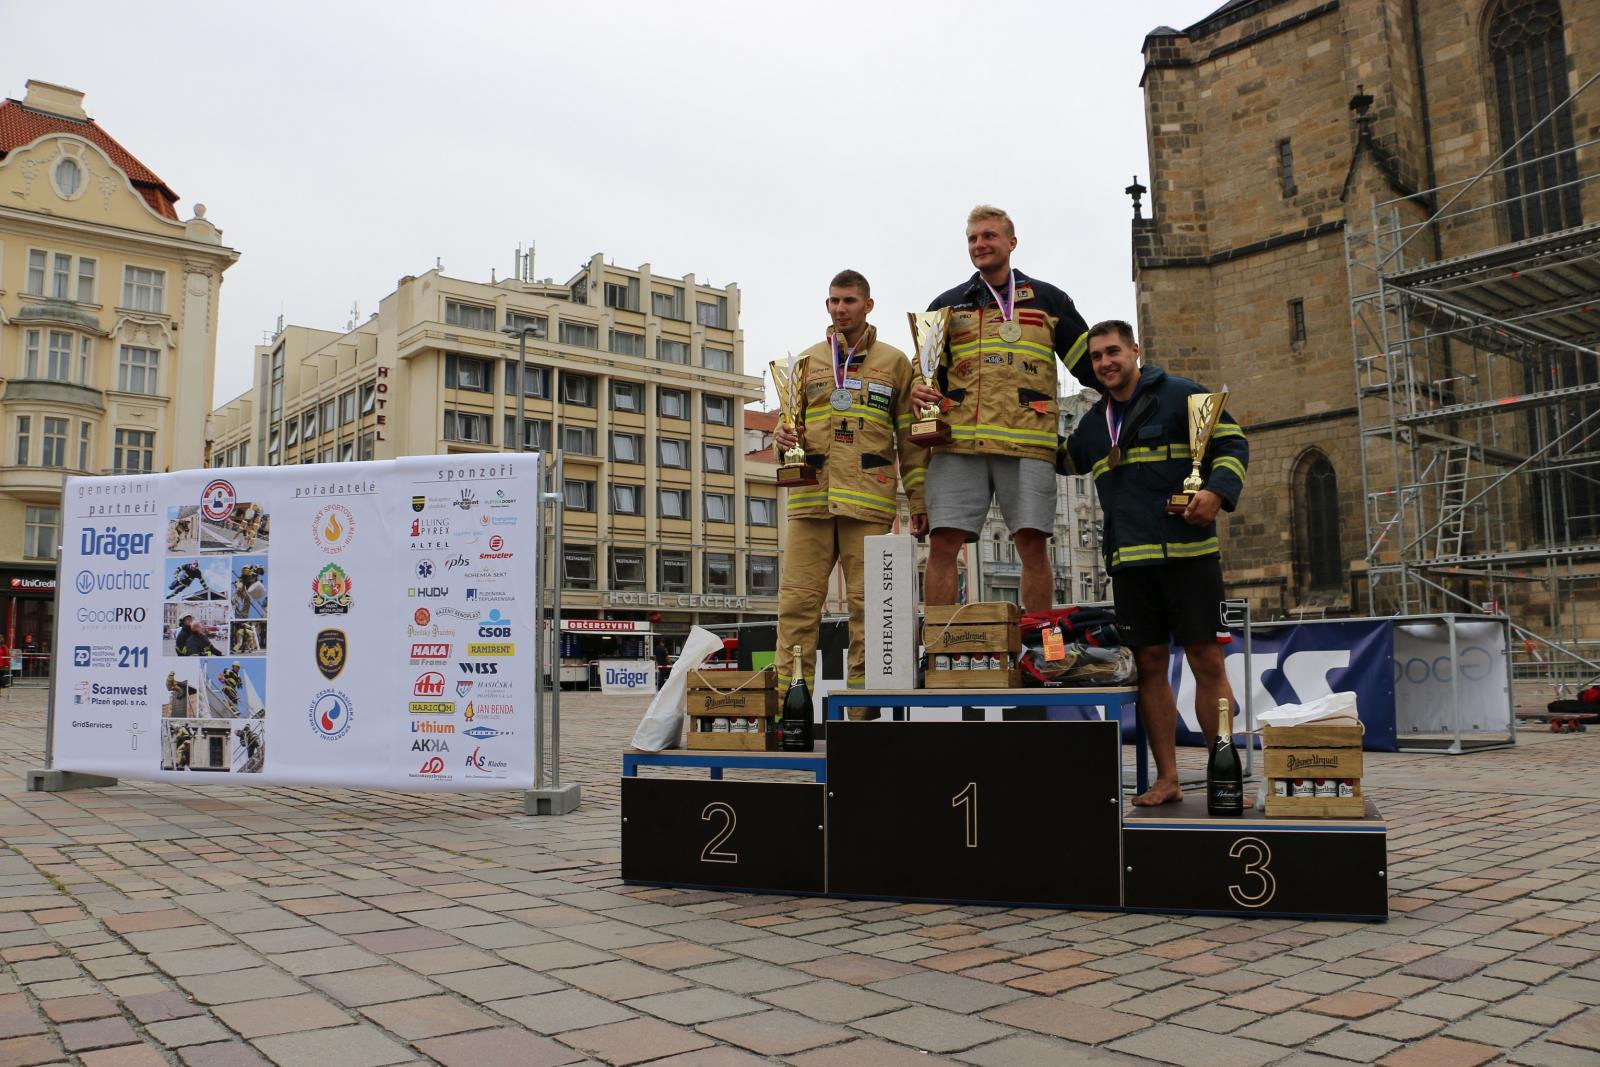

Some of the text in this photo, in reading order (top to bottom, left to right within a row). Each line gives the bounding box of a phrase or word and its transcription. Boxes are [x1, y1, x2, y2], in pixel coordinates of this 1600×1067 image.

[376, 366, 390, 441] HOTEL
[438, 464, 513, 481] sponzoři
[296, 481, 376, 498] pořadatelé
[89, 500, 155, 517] partneři
[80, 526, 154, 561] Dräger
[411, 541, 449, 549] ALTEL
[21, 579, 56, 588] UniCredit
[97, 570, 150, 591] vochoc
[418, 587, 449, 598] HUDY
[609, 591, 753, 609] HOTEL CENTRAL
[77, 607, 146, 622] GoodPRO
[882, 550, 893, 676] BOHEMIA SEKT
[478, 626, 511, 638] ČSOB
[569, 621, 634, 630] OBČERSTVENÍ
[118, 646, 148, 668] 211
[412, 645, 447, 656] HAKA
[471, 645, 511, 654] RAMIRENT
[459, 663, 498, 674] WISS
[606, 668, 648, 688] Dräger
[91, 683, 148, 696] Scanwest
[91, 697, 111, 705] Plzeň
[112, 698, 129, 707] spol.
[477, 704, 514, 714] JAN BENDA
[72, 721, 113, 729] GridServices
[411, 721, 456, 734] Lithium
[1286, 754, 1338, 772] Pilsner Urquell
[951, 782, 978, 848] 1
[700, 802, 738, 863] 2
[1228, 837, 1277, 908] 3
